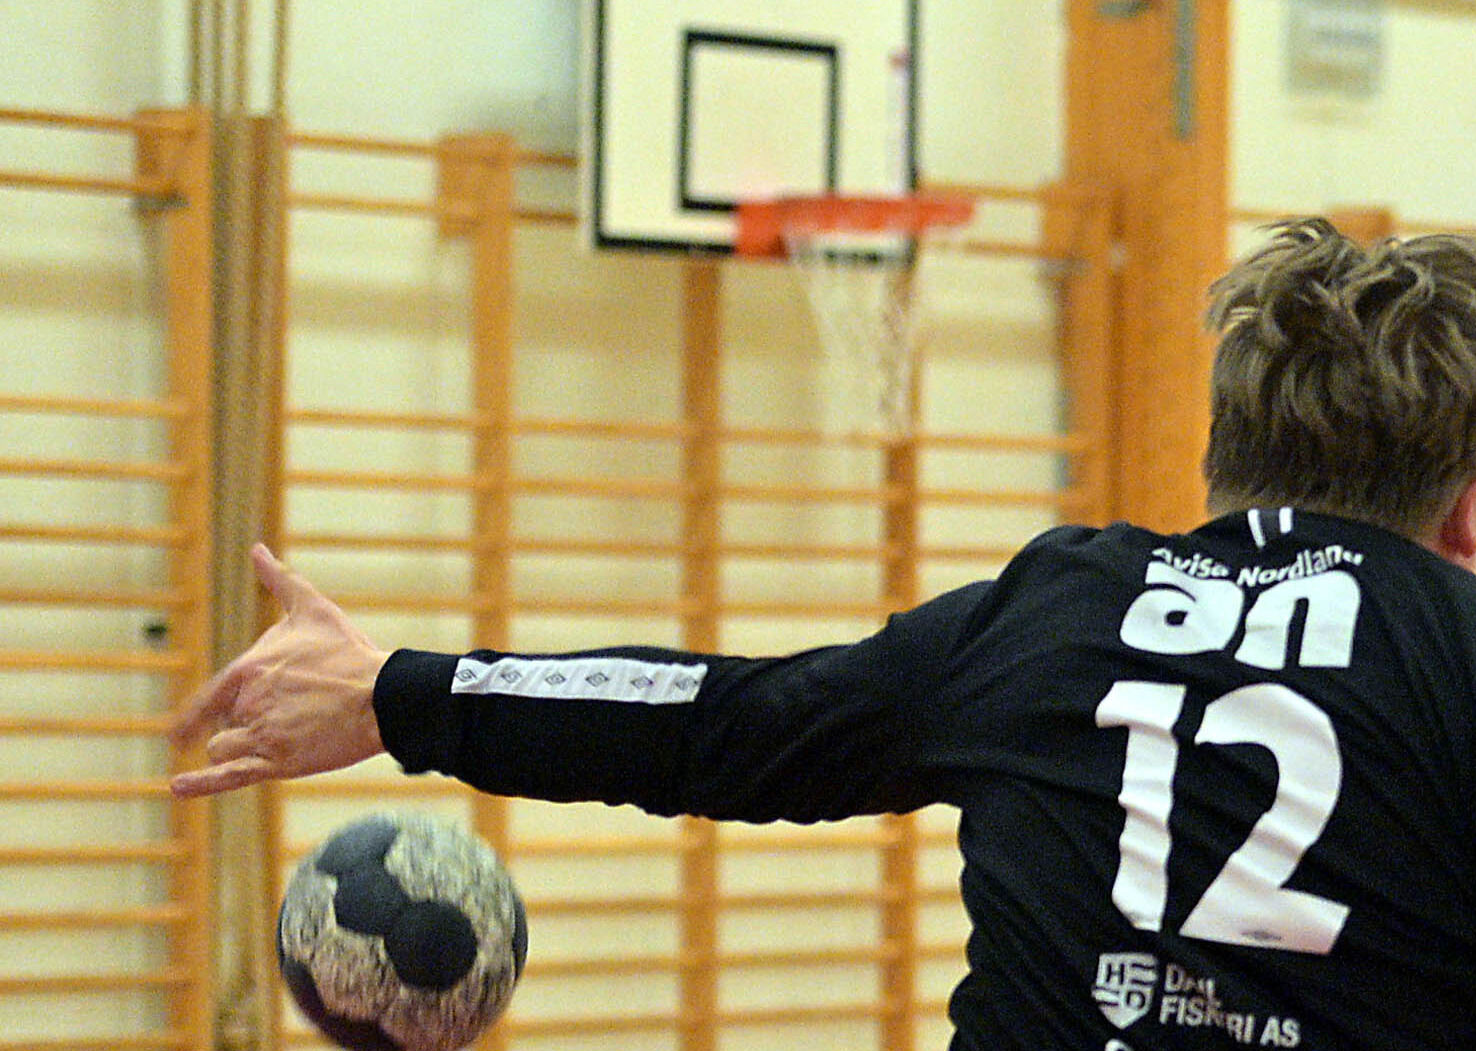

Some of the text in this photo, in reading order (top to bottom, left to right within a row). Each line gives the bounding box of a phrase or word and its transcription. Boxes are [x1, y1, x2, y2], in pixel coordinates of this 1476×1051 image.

[1118, 561, 1362, 671] an
[1095, 679, 1351, 956] 12
[1159, 994, 1301, 1049] FISKRI AS
